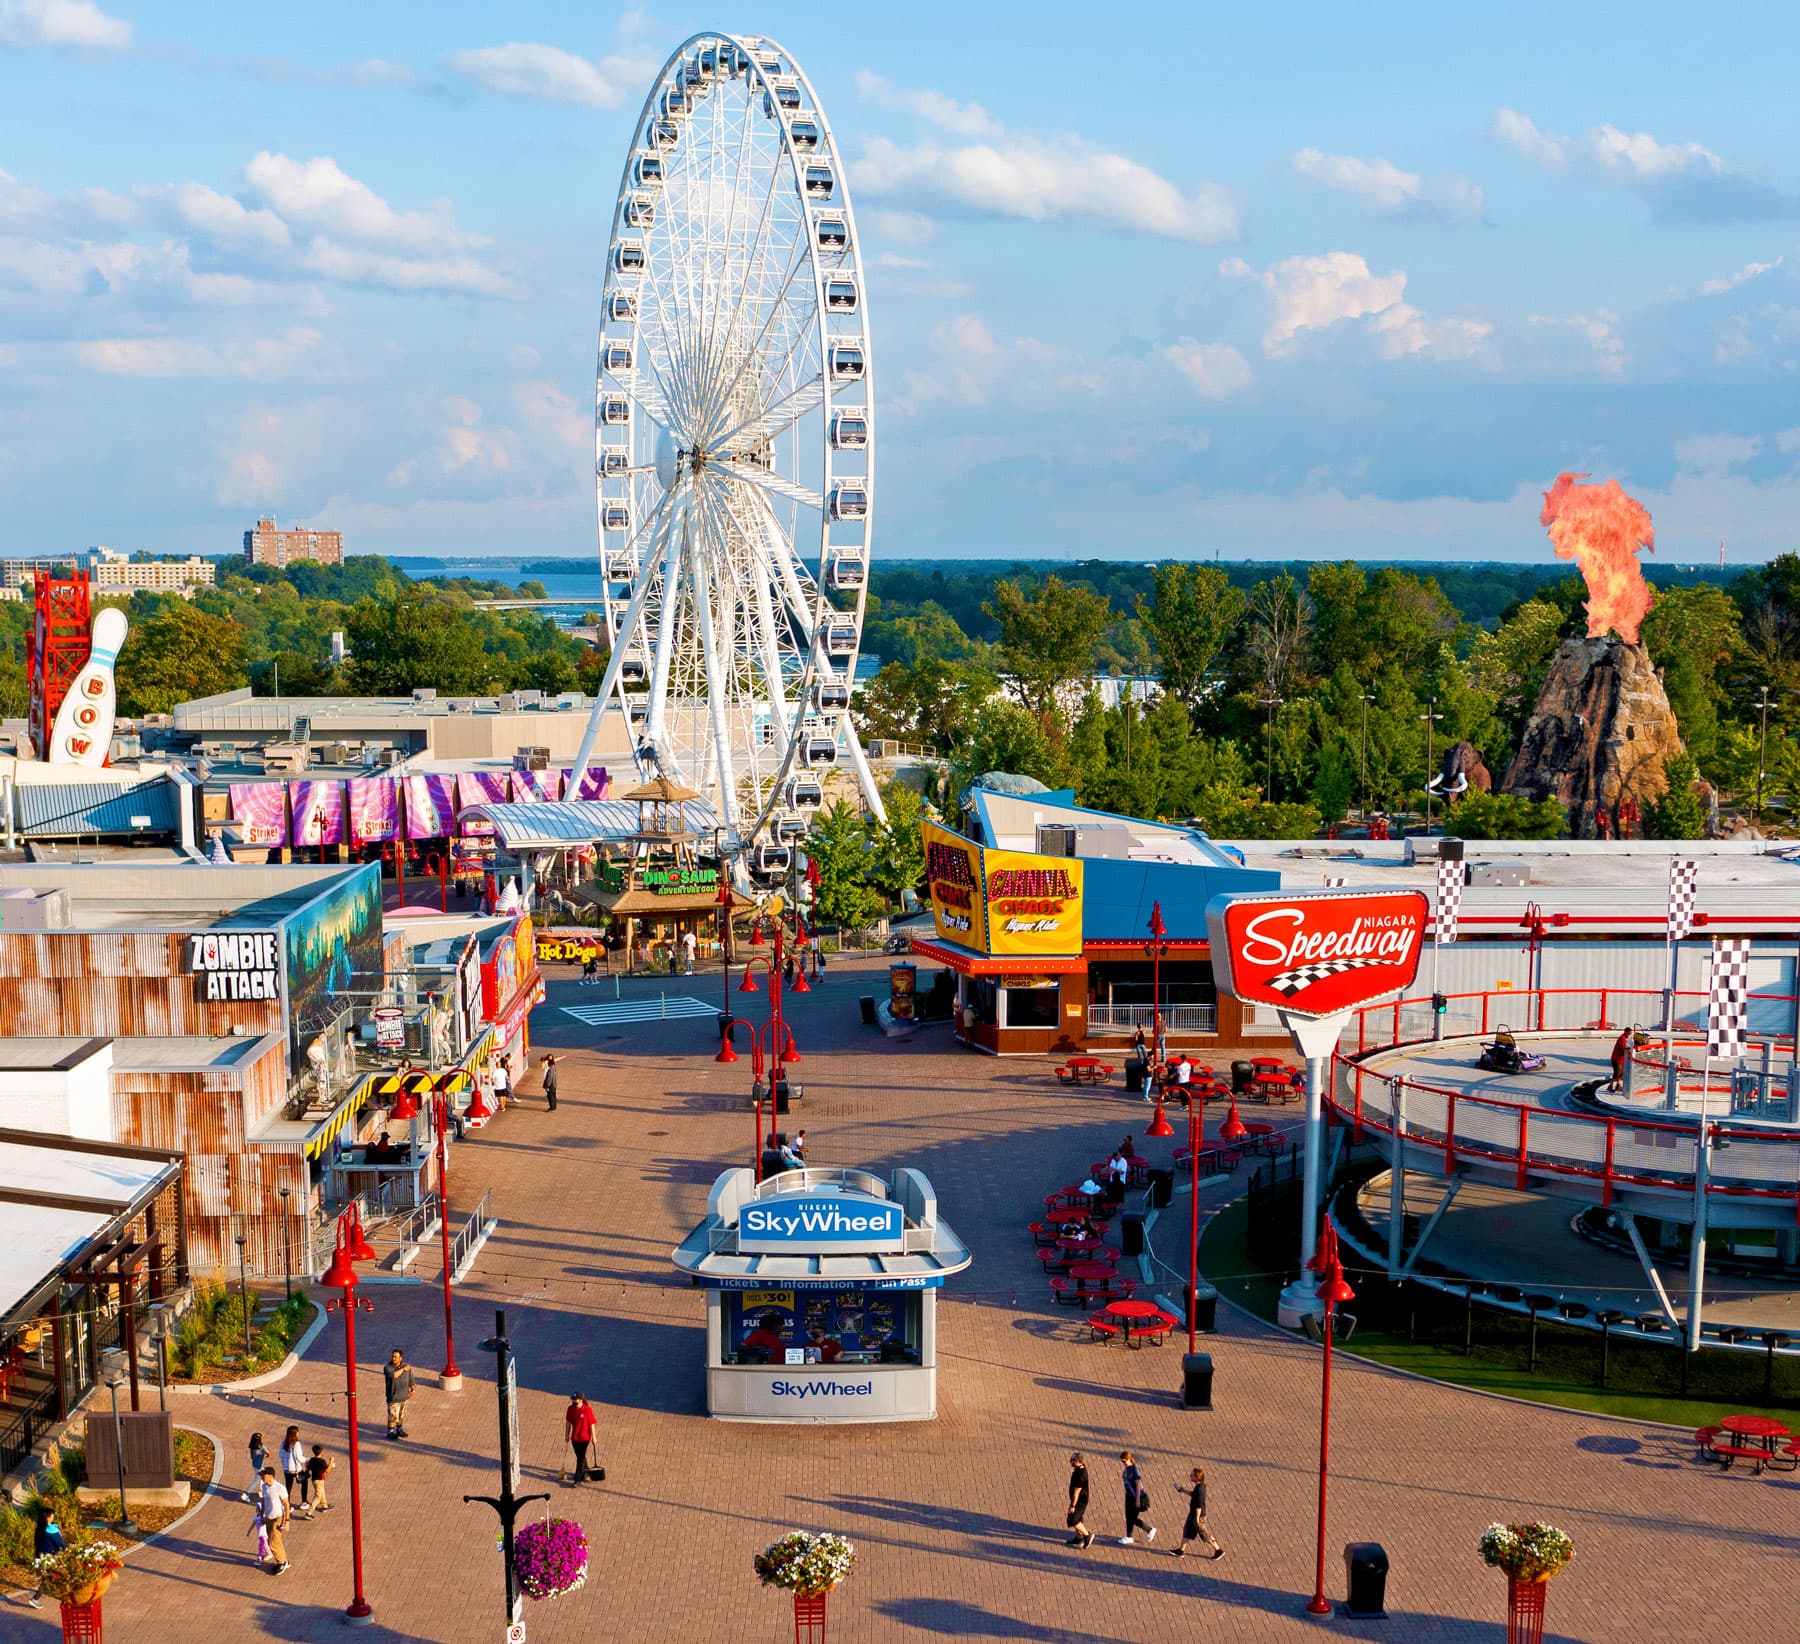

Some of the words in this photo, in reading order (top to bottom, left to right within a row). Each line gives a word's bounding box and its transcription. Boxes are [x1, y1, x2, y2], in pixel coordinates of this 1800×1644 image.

[250, 826, 278, 842] Strike!
[643, 868, 717, 885] DINOSAUR
[658, 886, 700, 895] ADVENTURE
[988, 869, 1079, 902] CARNIVAL
[999, 899, 1065, 916] CHAOS
[1034, 919, 1061, 932] Ride
[1363, 914, 1416, 928] NIAGARA
[1241, 908, 1416, 967] Speedway
[191, 934, 275, 970] ZOMBIE
[537, 943, 563, 961] Hot
[564, 942, 597, 964] Dogs
[207, 971, 276, 999] ATTACK
[747, 1211, 892, 1236] SkyWheel
[720, 1279, 760, 1288] Tickets
[780, 1280, 854, 1289] Information
[874, 1279, 897, 1288] Fun
[900, 1278, 927, 1287] Pass
[770, 1381, 872, 1399] SkyWheel
